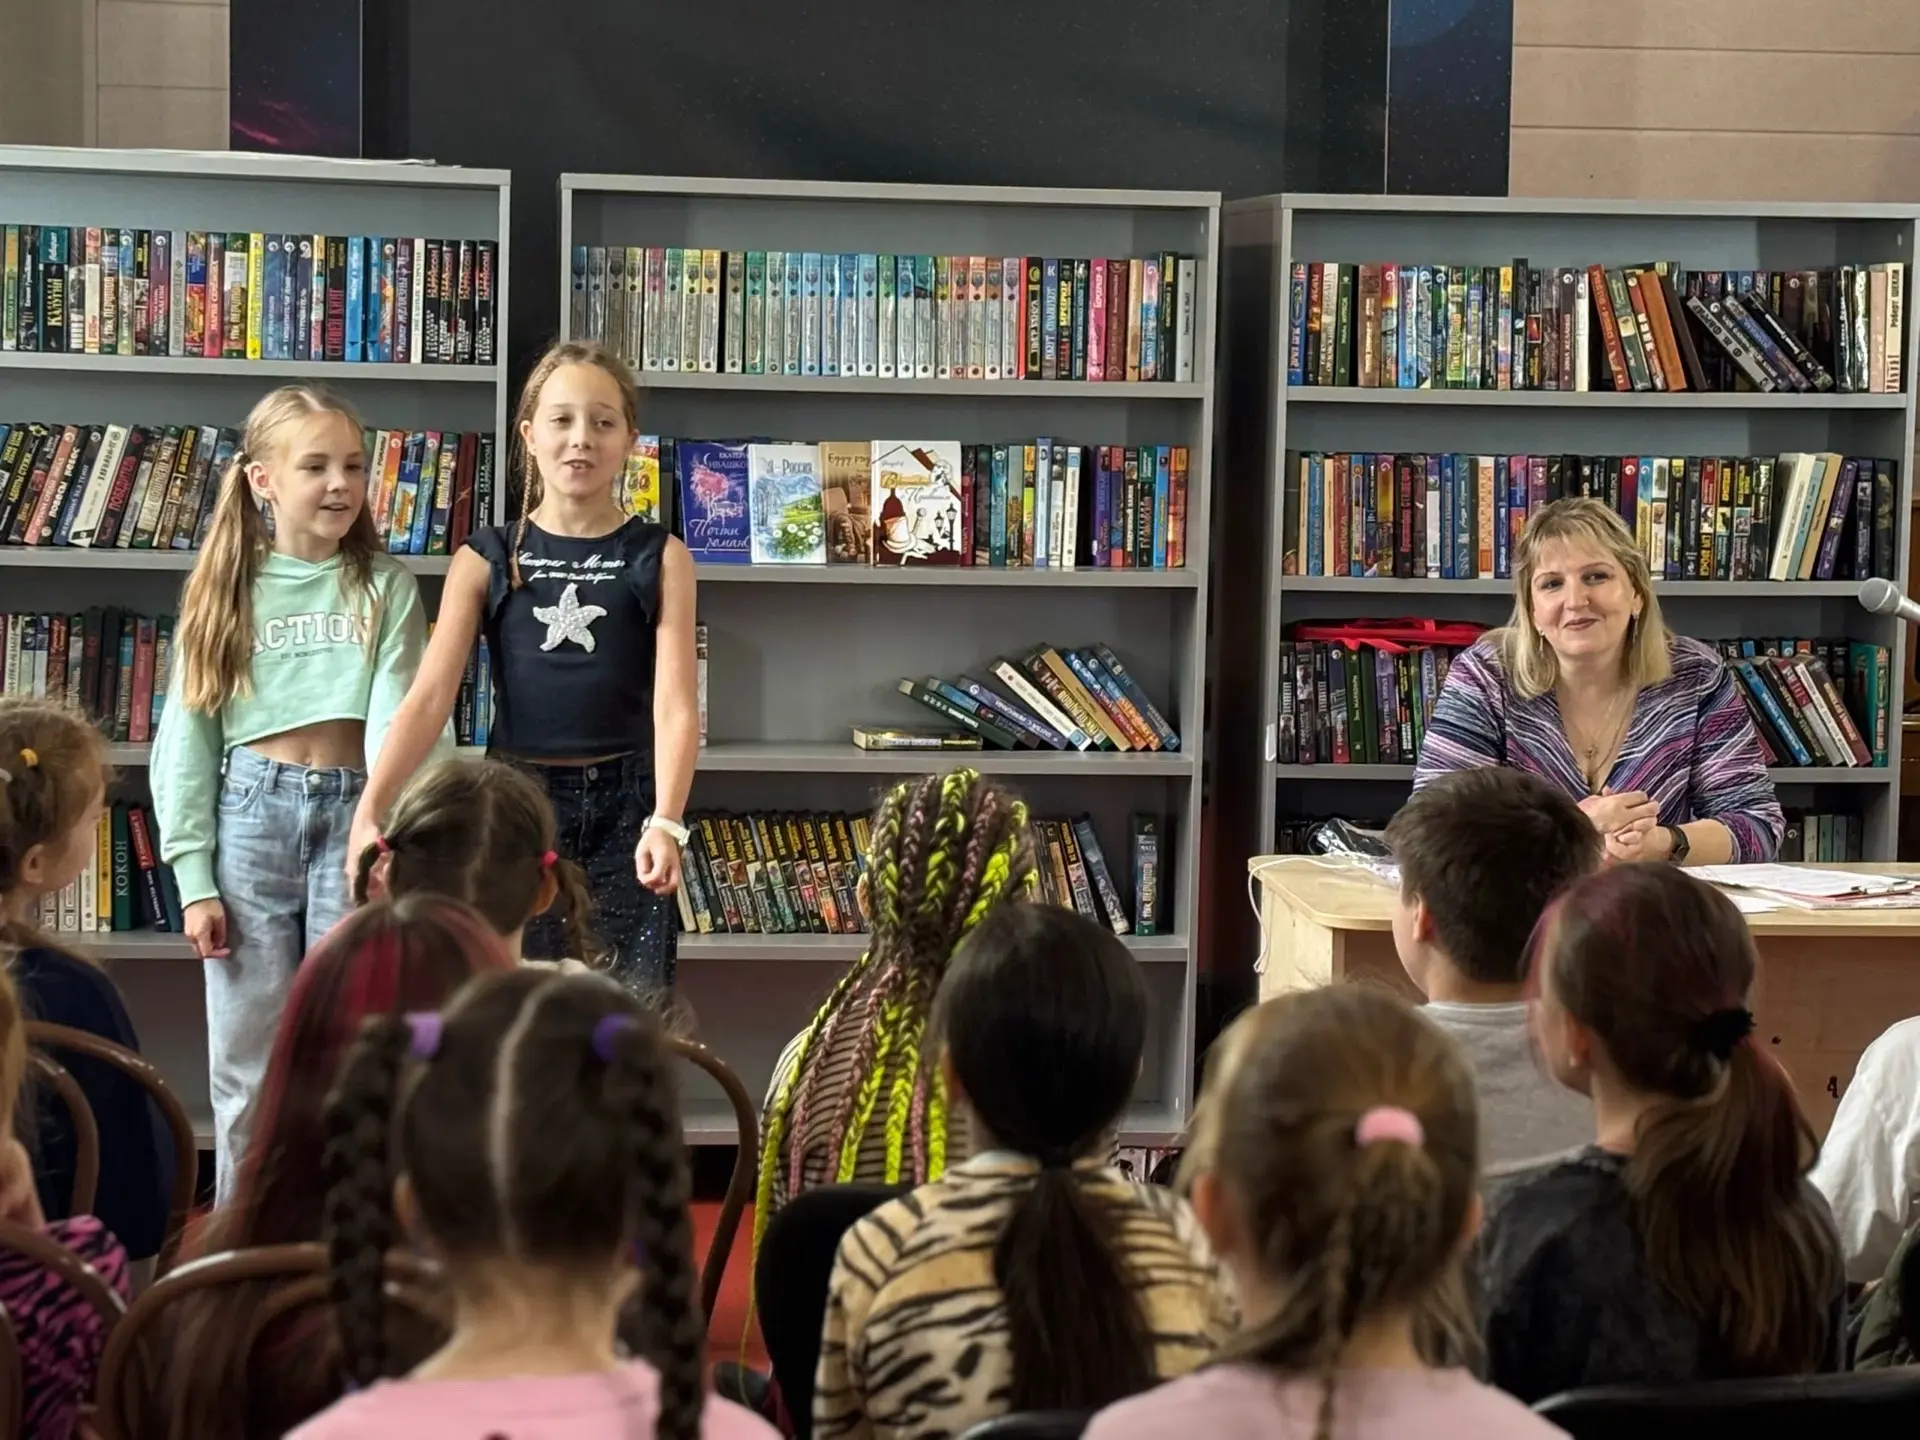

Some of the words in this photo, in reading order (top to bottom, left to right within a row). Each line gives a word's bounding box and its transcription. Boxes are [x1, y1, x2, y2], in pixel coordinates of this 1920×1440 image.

[48, 278, 63, 326] КАЛУГИН
[103, 276, 115, 318] ПЕРУМОВ
[328, 287, 344, 314] КИНГ
[327, 318, 343, 356] СТИВЕН
[107, 455, 136, 512] ПОБЕДИТЕЛЬ
[689, 519, 740, 538] Почти
[115, 839, 129, 897] КОКОН
